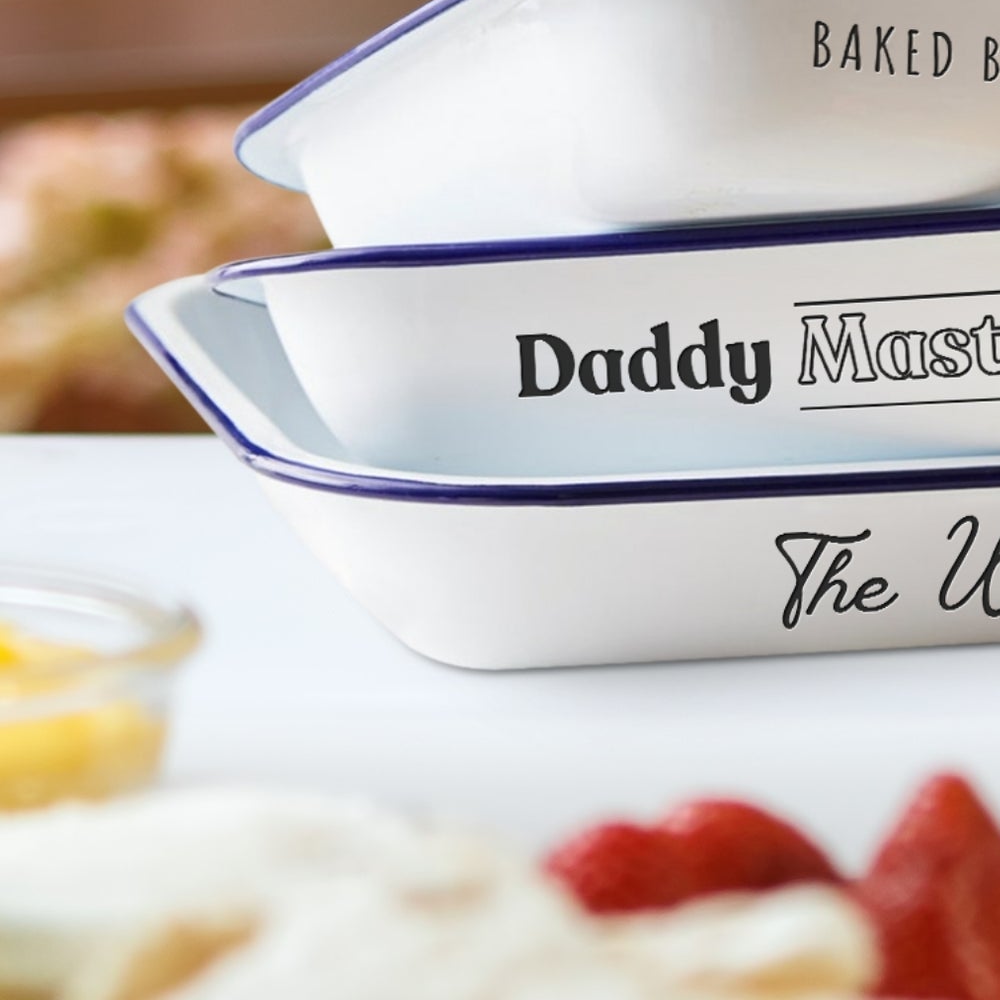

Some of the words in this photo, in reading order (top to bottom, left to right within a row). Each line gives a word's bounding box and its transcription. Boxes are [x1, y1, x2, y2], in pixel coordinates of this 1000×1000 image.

[811, 20, 953, 78] BAKED
[515, 318, 772, 405] Daddy
[774, 528, 900, 630] The
